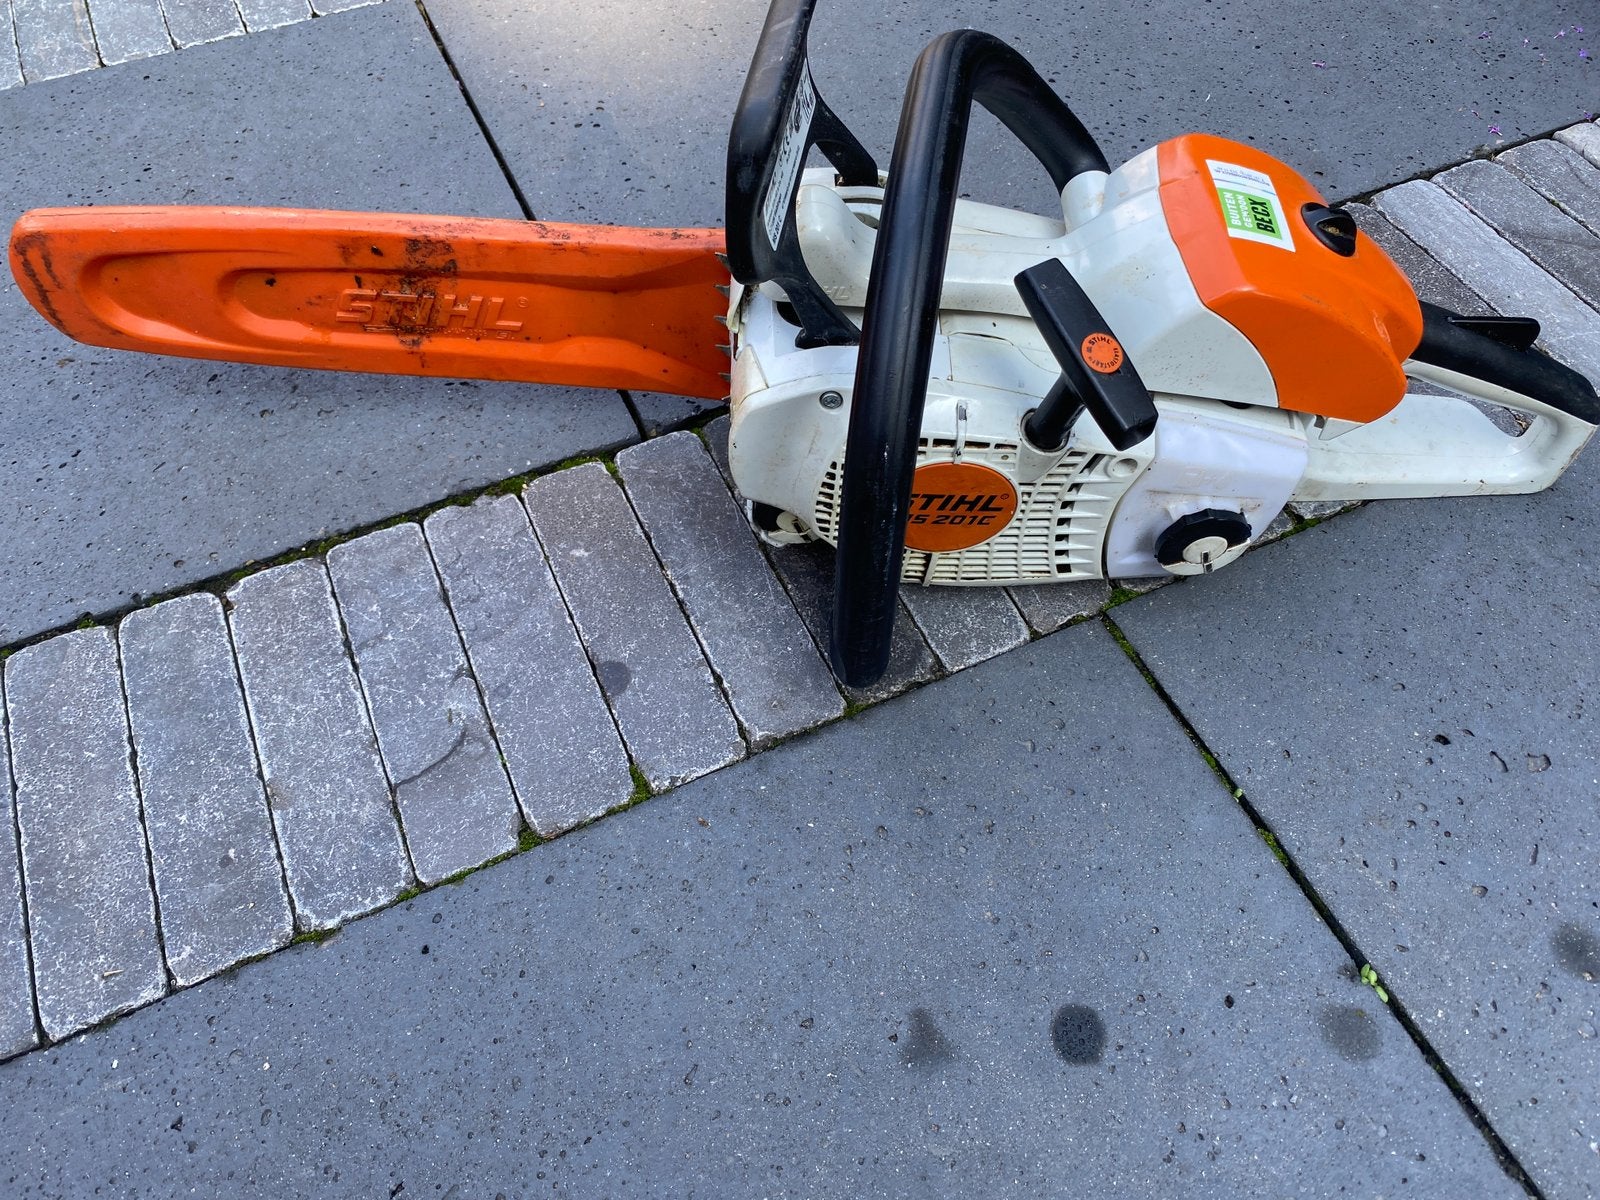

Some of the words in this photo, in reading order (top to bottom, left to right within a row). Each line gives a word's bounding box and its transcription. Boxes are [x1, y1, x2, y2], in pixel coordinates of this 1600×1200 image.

[1223, 192, 1242, 226] BUITEN
[1236, 194, 1253, 228] GEWOON
[1248, 197, 1276, 234] BECX
[336, 288, 523, 331] STIHL
[1089, 336, 1111, 345] STIHL
[931, 515, 997, 526] 201C
